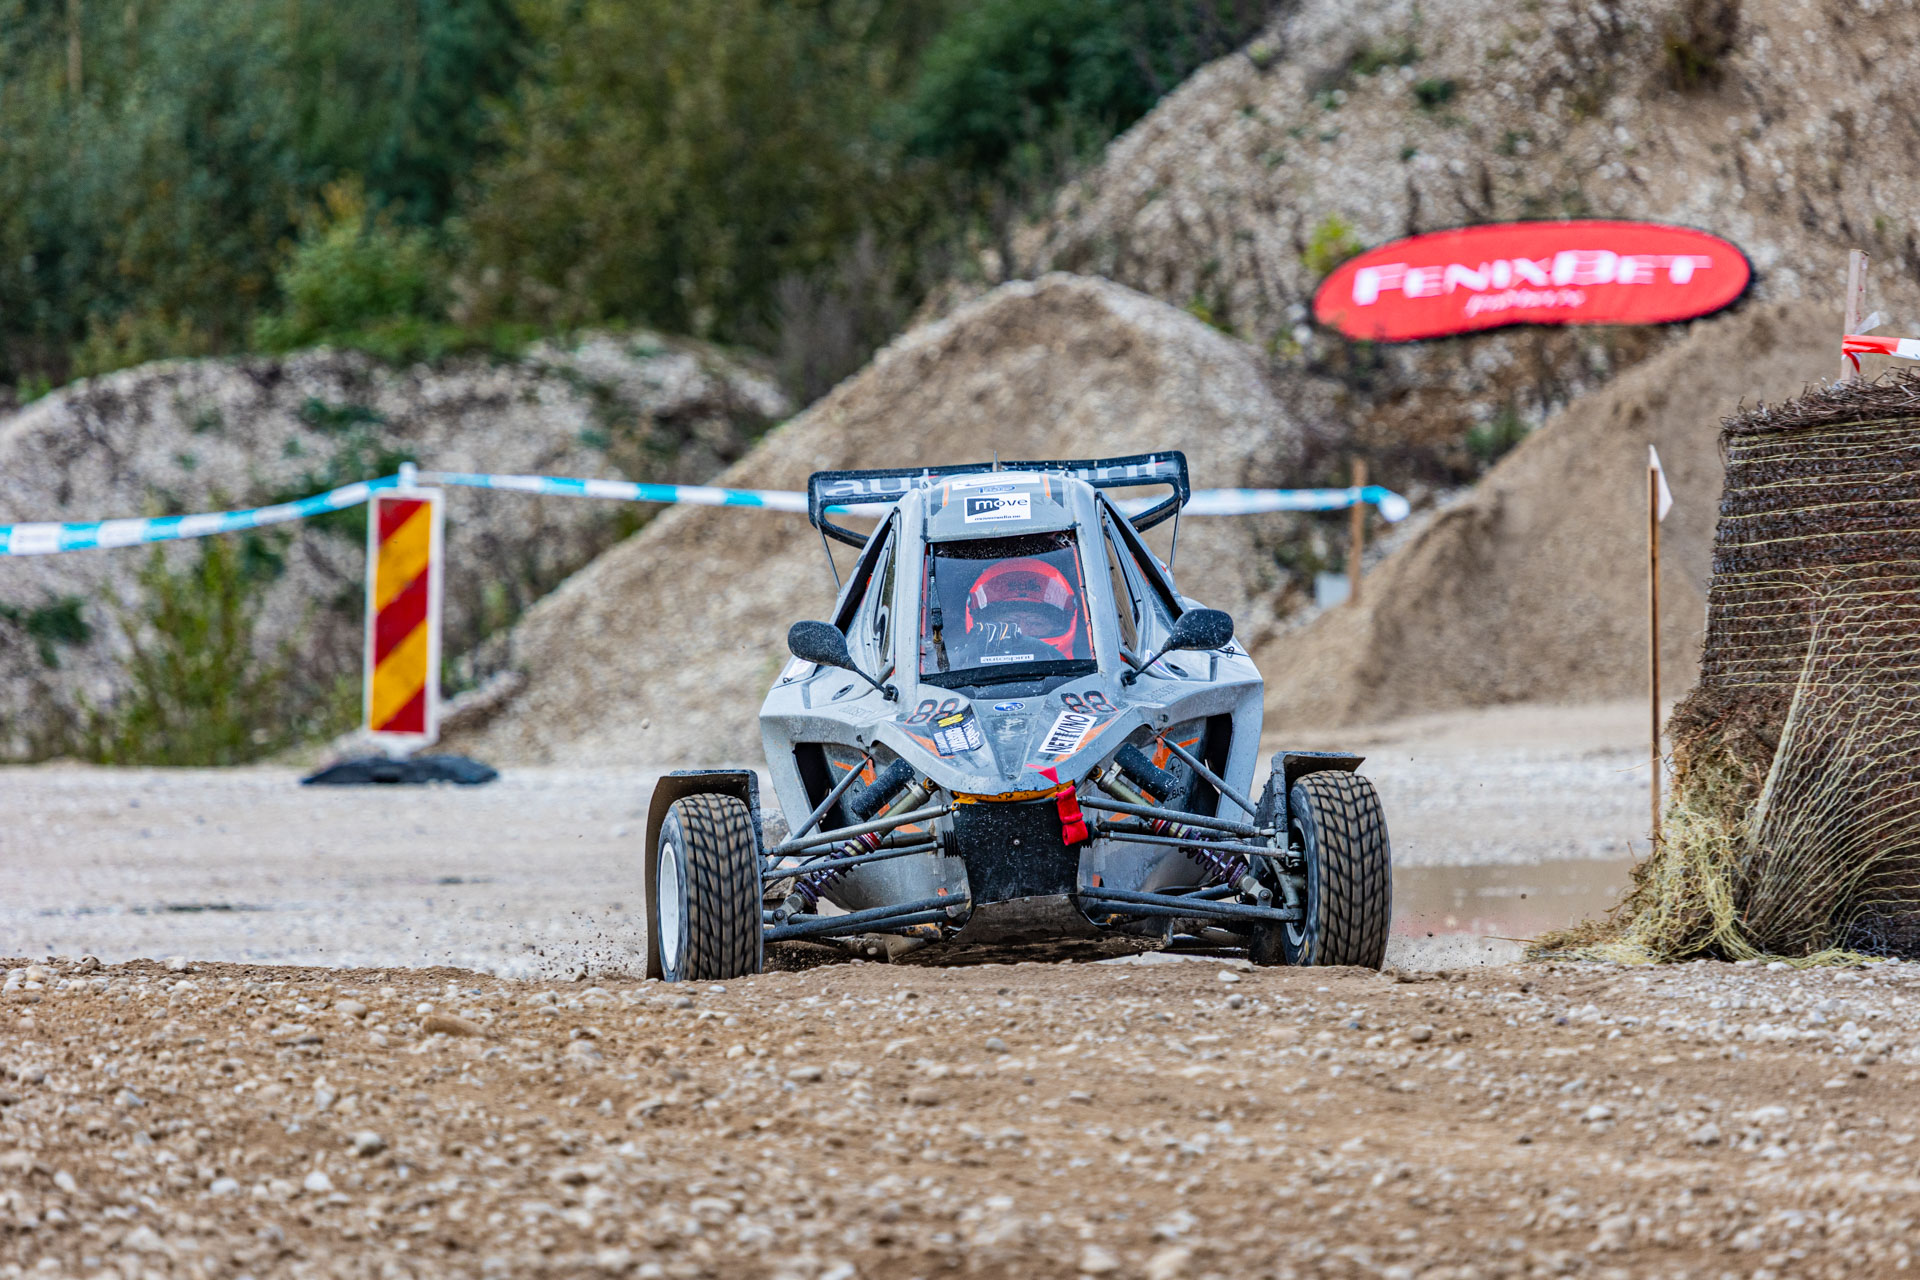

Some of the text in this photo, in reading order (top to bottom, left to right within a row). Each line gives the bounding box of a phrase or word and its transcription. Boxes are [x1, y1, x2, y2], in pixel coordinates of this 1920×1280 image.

[976, 497, 1029, 511] move
[904, 697, 960, 725] 88
[1061, 690, 1119, 714] 88
